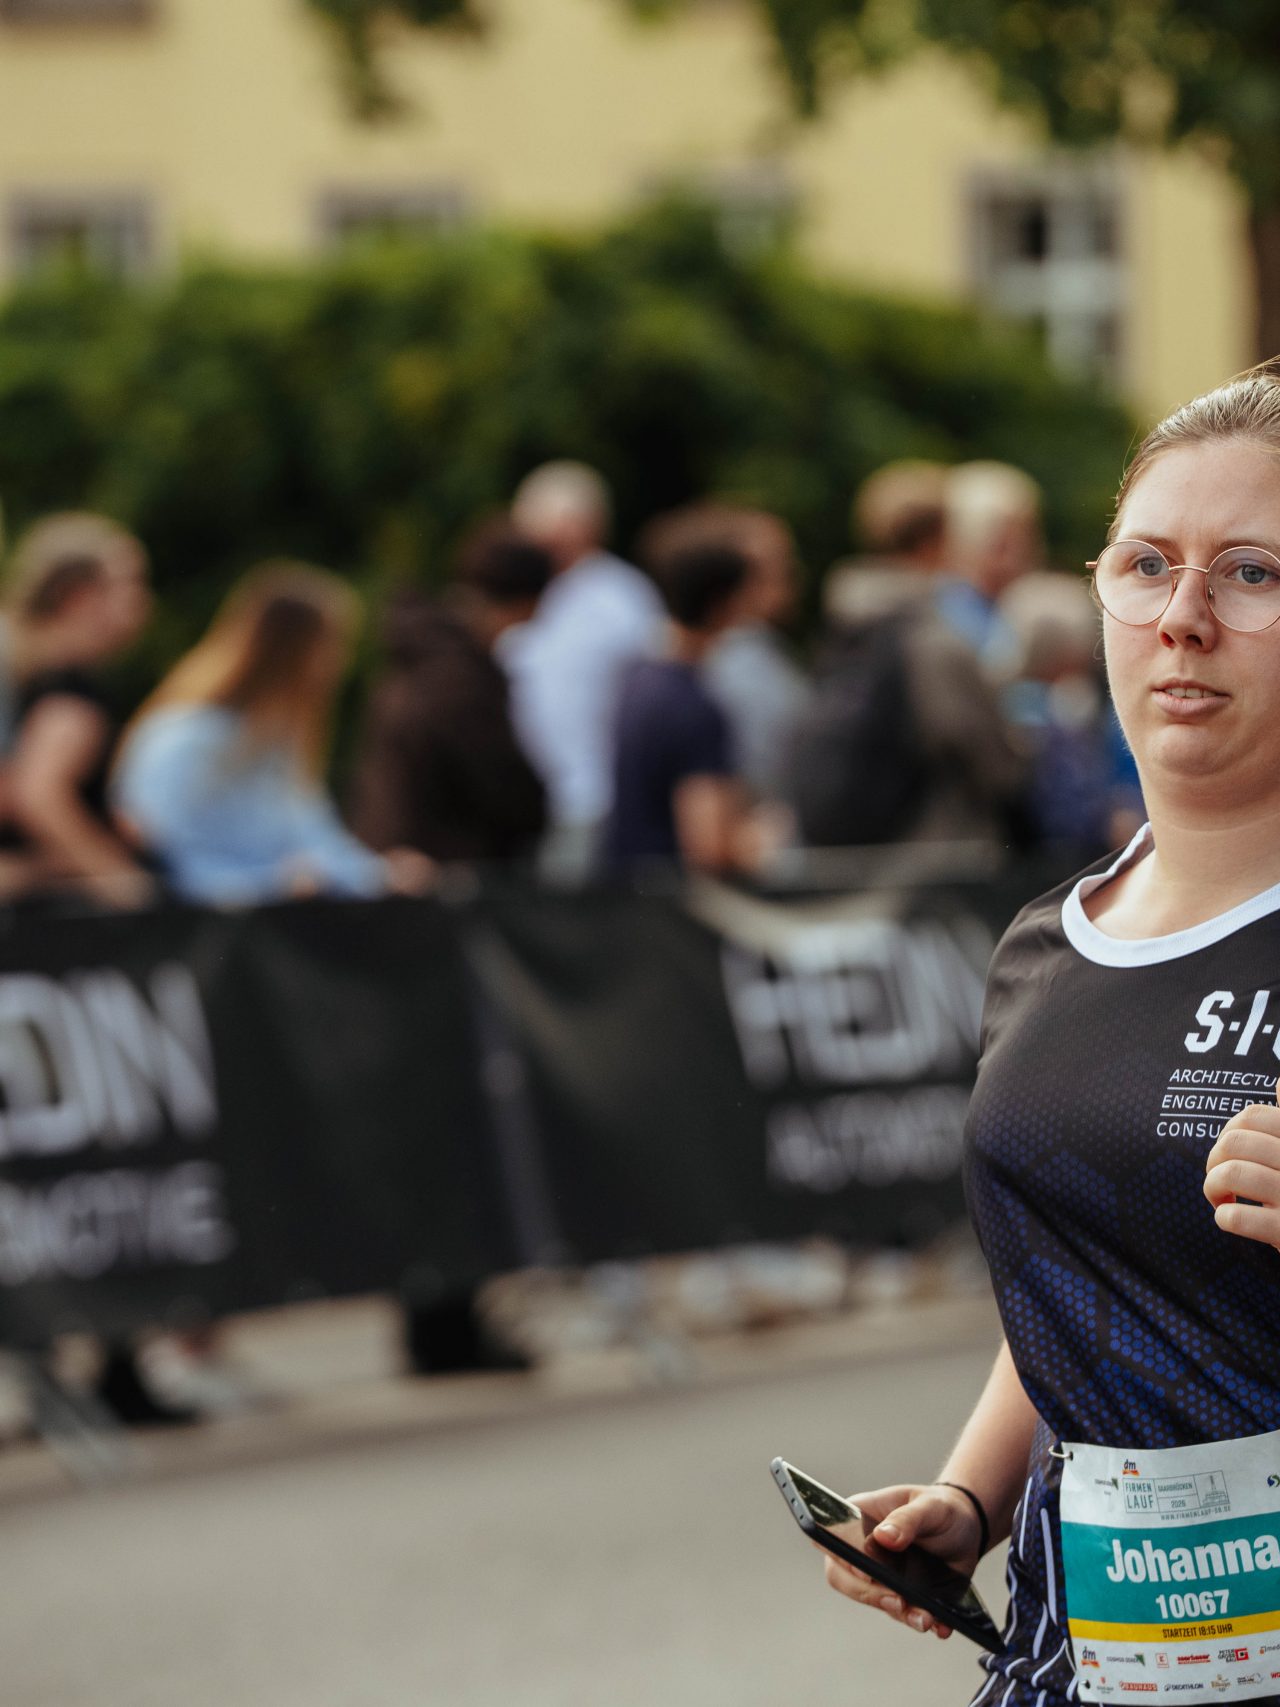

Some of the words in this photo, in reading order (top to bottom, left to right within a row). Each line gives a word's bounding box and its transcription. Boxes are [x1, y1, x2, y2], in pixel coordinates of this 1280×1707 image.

[1156, 1121, 1221, 1139] CONSU
[1124, 1459, 1136, 1470] dm
[1125, 1482, 1153, 1492] FIRMEN
[1126, 1495, 1154, 1509] LAUF
[1155, 1589, 1230, 1619] 10067
[1162, 1626, 1197, 1638] STARTZEIT
[1198, 1624, 1216, 1636] 18:15
[1216, 1623, 1233, 1634] UHR
[1082, 1646, 1096, 1660] dm
[1171, 1682, 1204, 1691] DECATHLON
